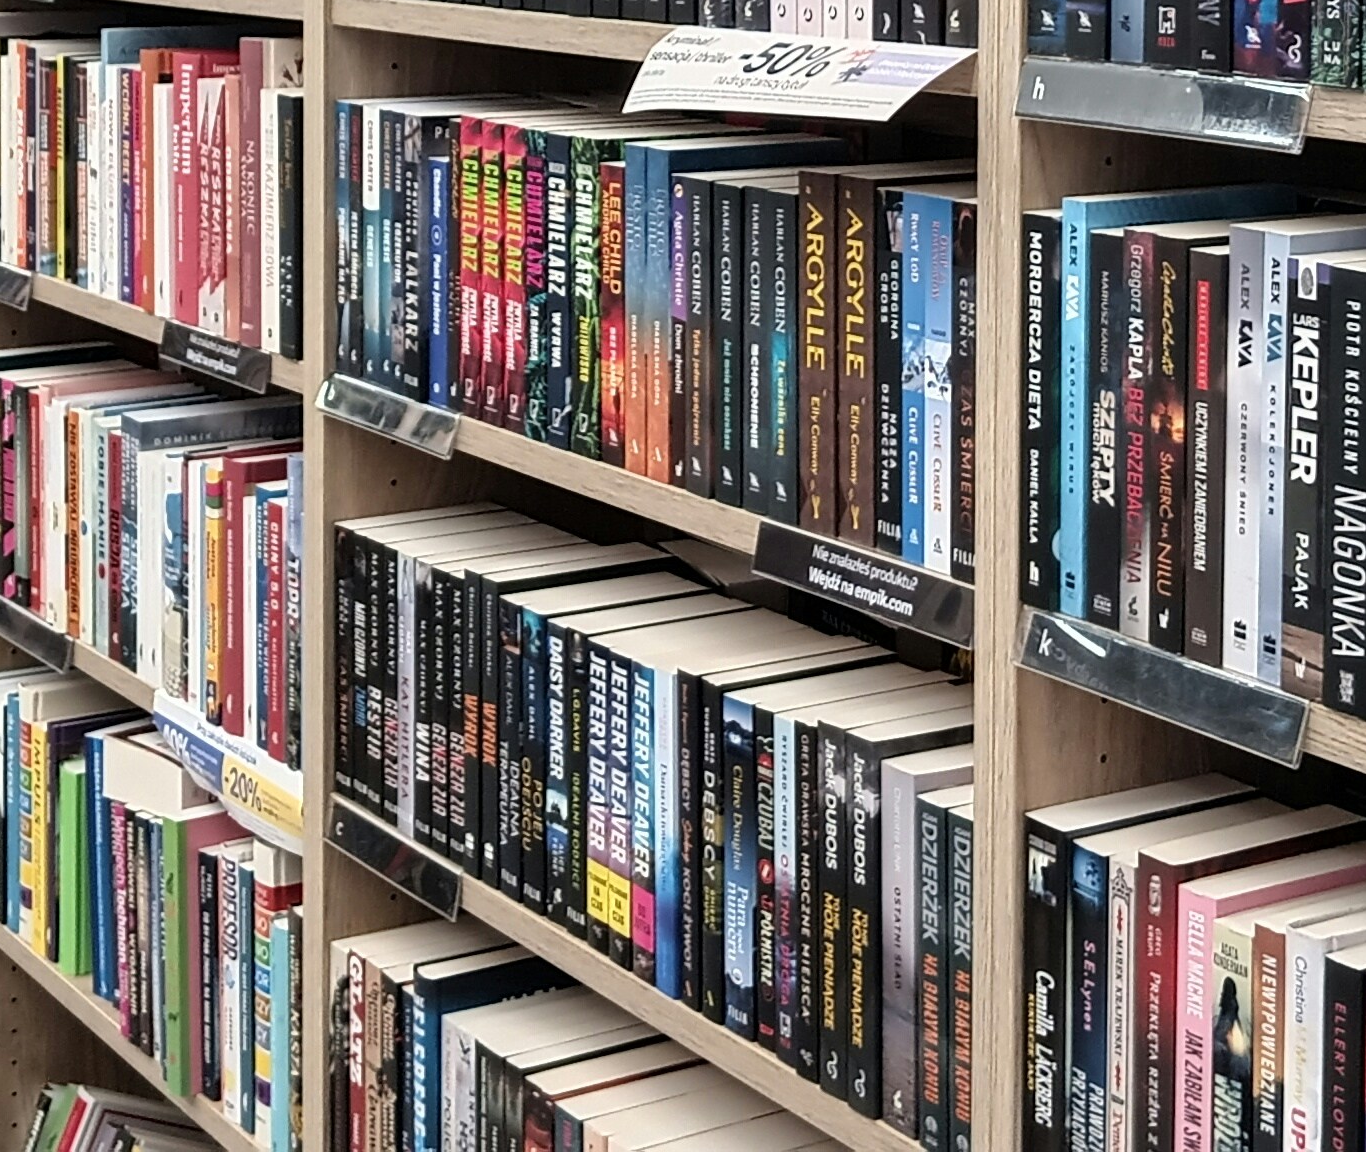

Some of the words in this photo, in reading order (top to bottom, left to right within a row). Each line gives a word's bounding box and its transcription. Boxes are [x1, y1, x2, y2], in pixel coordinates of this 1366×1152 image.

[738, 42, 847, 78] -50%
[179, 64, 194, 173] Imperium
[547, 177, 565, 297] CHMIELARZ
[804, 201, 826, 371] ARGYLLE
[1029, 231, 1041, 360] MORDERCZA
[1028, 368, 1040, 430] DIETA
[1291, 329, 1319, 484] KEPLER
[809, 566, 842, 590] Wejdź
[840, 580, 853, 595] na
[855, 585, 913, 616] empik.com
[812, 544, 829, 560] Nie
[829, 552, 871, 576] znalazłeś
[870, 566, 918, 590] produktu?
[590, 651, 607, 750] JEFFERY
[588, 755, 605, 851] DEAVER
